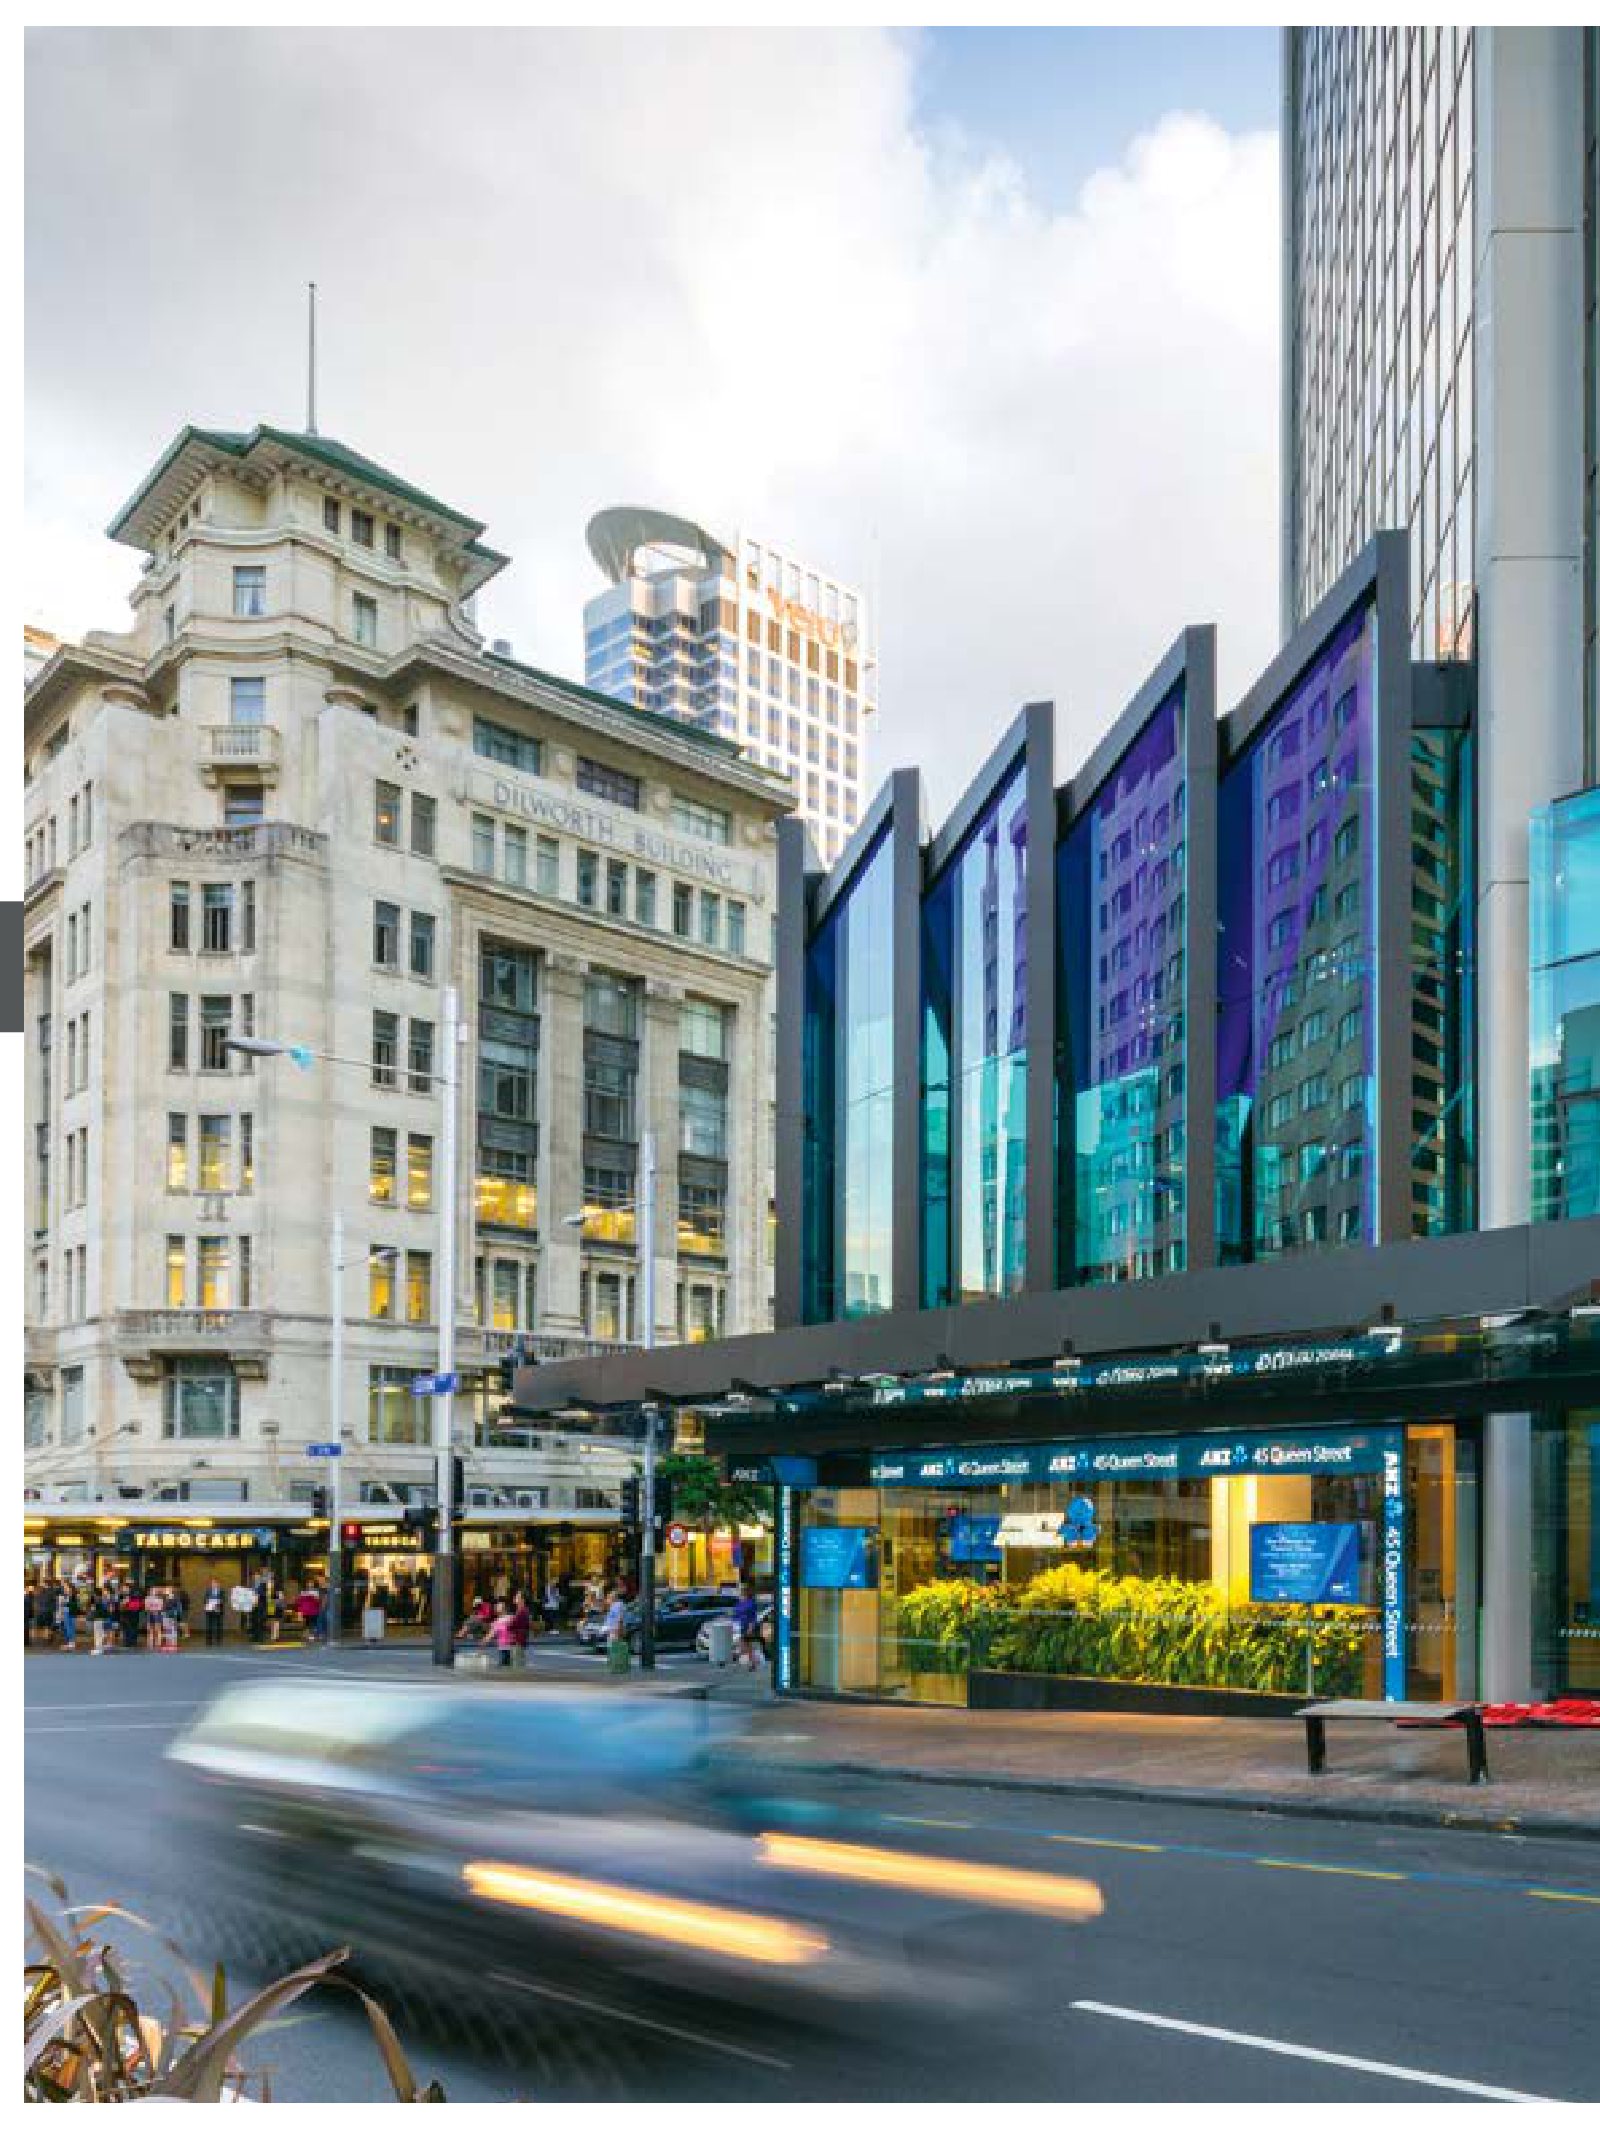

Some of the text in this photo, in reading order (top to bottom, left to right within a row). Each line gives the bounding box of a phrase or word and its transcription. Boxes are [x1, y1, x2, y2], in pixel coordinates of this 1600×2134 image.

[494, 781, 735, 881] DILWORTH BUILDING
[1271, 1446, 1311, 1465] Queen
[1314, 1446, 1351, 1462] Street
[1385, 1550, 1400, 1605] Queen
[1385, 1608, 1400, 1657] Street
